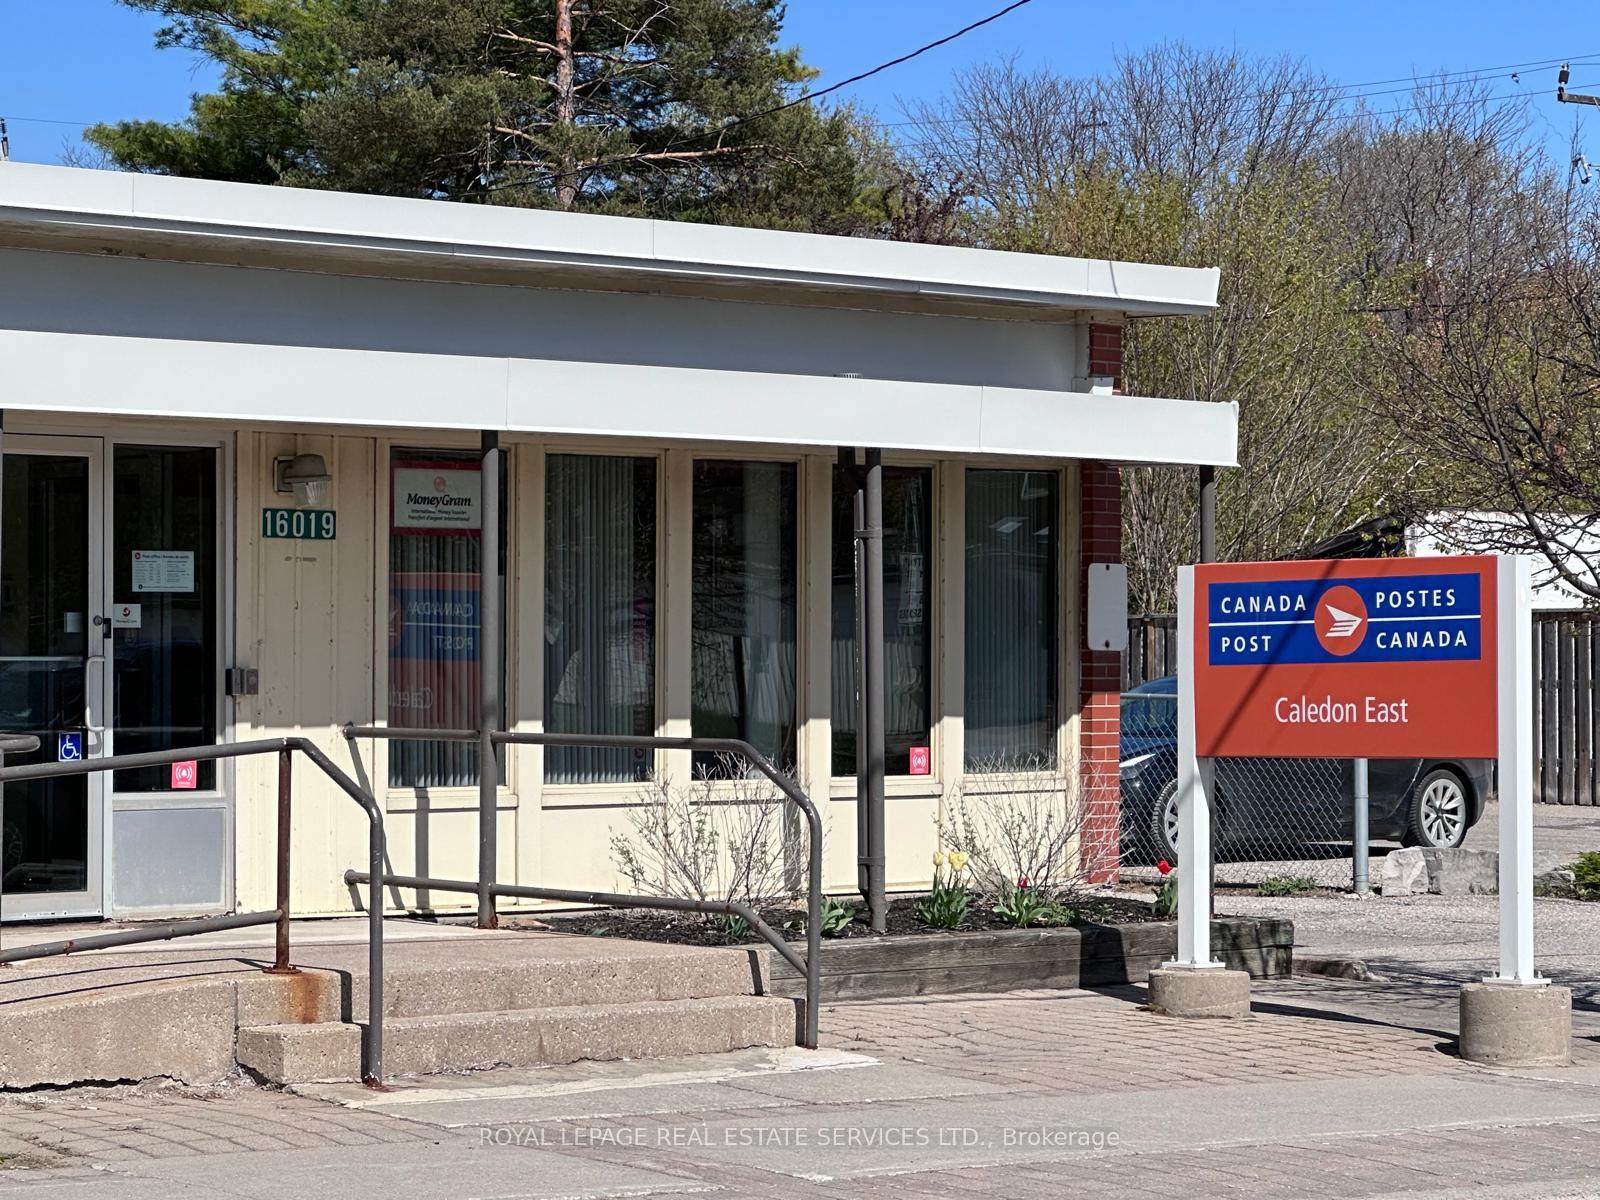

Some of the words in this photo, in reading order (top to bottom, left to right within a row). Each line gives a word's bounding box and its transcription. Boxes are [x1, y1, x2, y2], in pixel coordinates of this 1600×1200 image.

[406, 493, 472, 508] MoneyGram
[265, 510, 334, 538] 16019
[1221, 595, 1307, 614] CANADA
[1376, 589, 1456, 609] POSTES
[1221, 636, 1272, 653] POST
[1376, 630, 1468, 649] CANADA
[1275, 695, 1357, 723] Caledon
[1365, 696, 1409, 723] East
